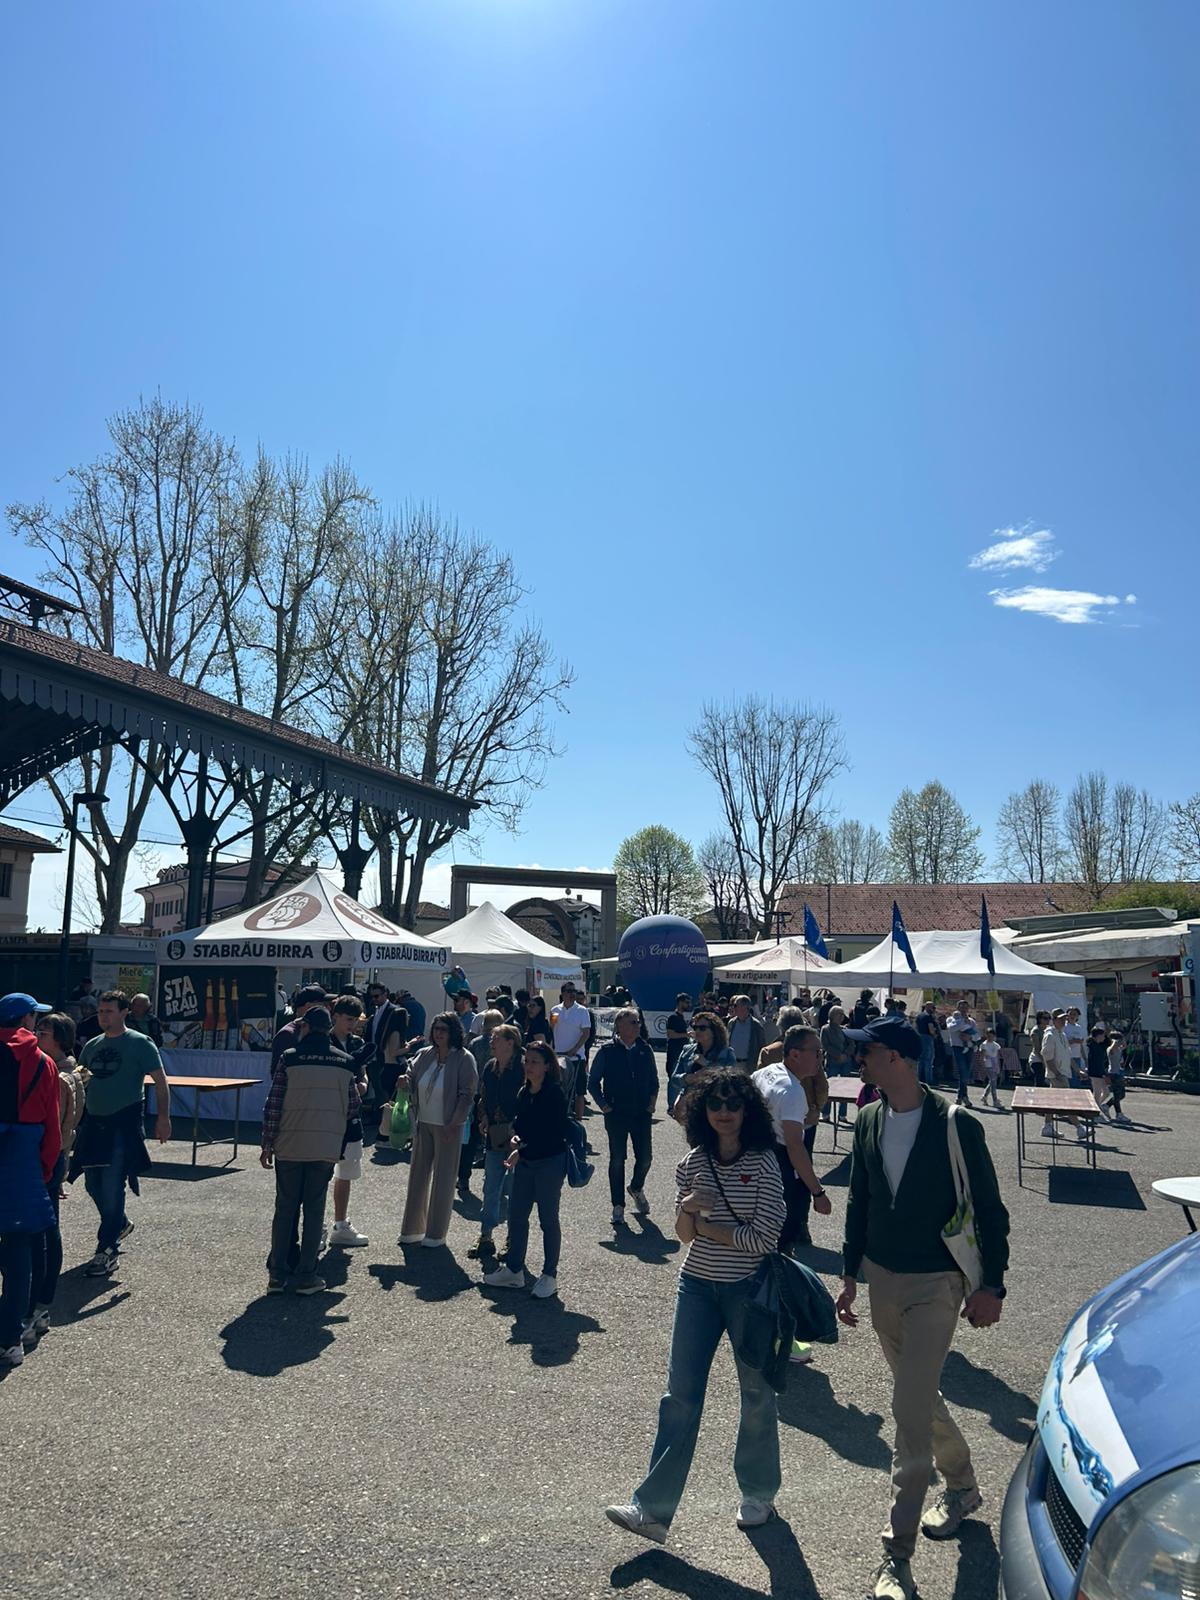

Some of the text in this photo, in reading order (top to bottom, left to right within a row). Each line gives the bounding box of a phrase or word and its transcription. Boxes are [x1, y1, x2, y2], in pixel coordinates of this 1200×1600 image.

[193, 941, 314, 959] STABRÄU BIRRA
[725, 971, 778, 981] Birra artigianale
[164, 975, 195, 1001] STA
